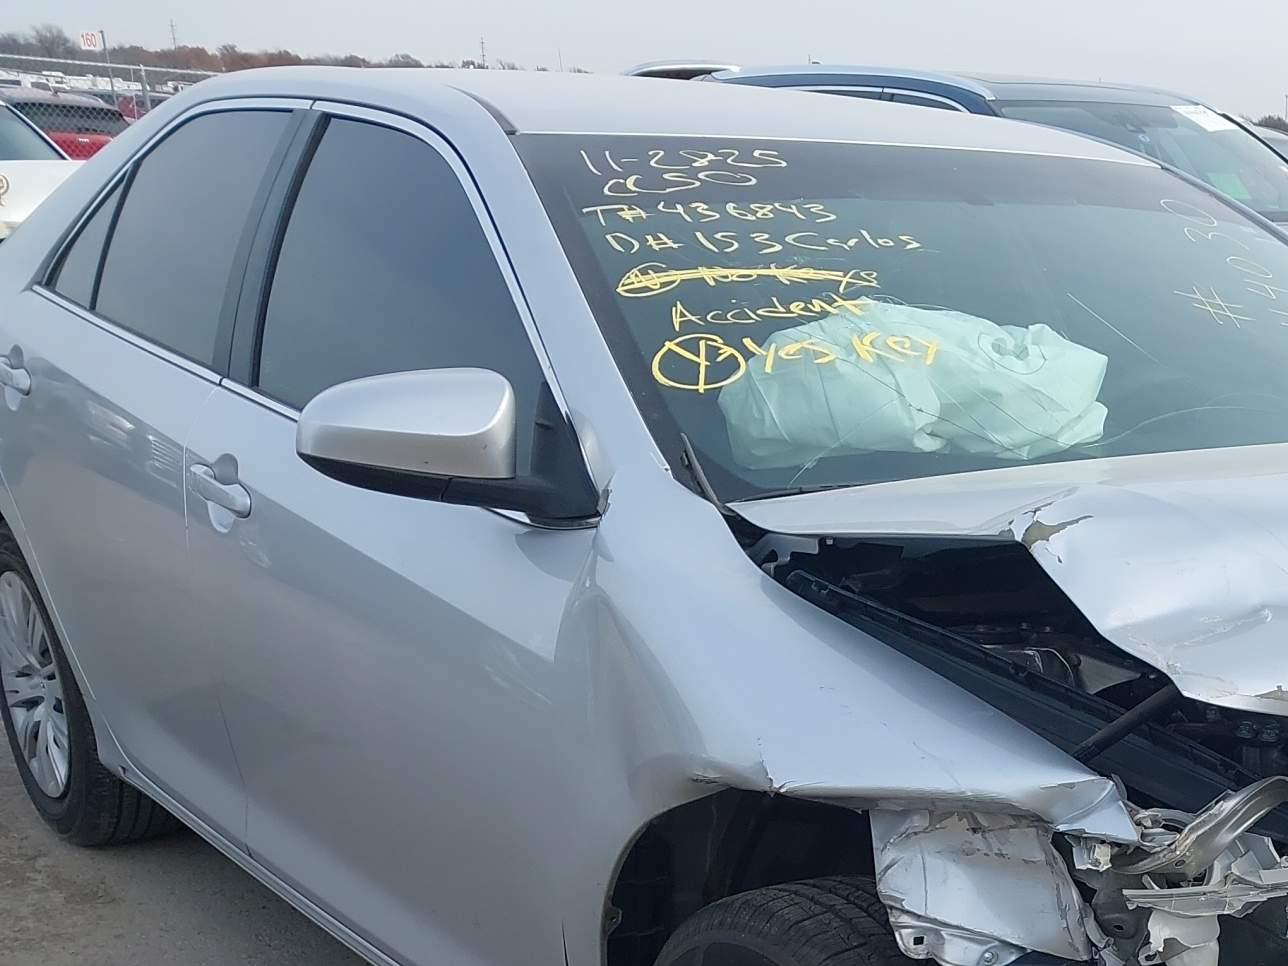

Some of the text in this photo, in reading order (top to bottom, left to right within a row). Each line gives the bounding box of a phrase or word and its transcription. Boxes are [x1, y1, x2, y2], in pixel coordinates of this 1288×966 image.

[81, 31, 97, 48] 160
[657, 201, 838, 223] 436843
[694, 230, 784, 254] 153
[671, 292, 868, 331] Accident
[742, 337, 837, 374] Yes
[853, 331, 938, 366] Key
